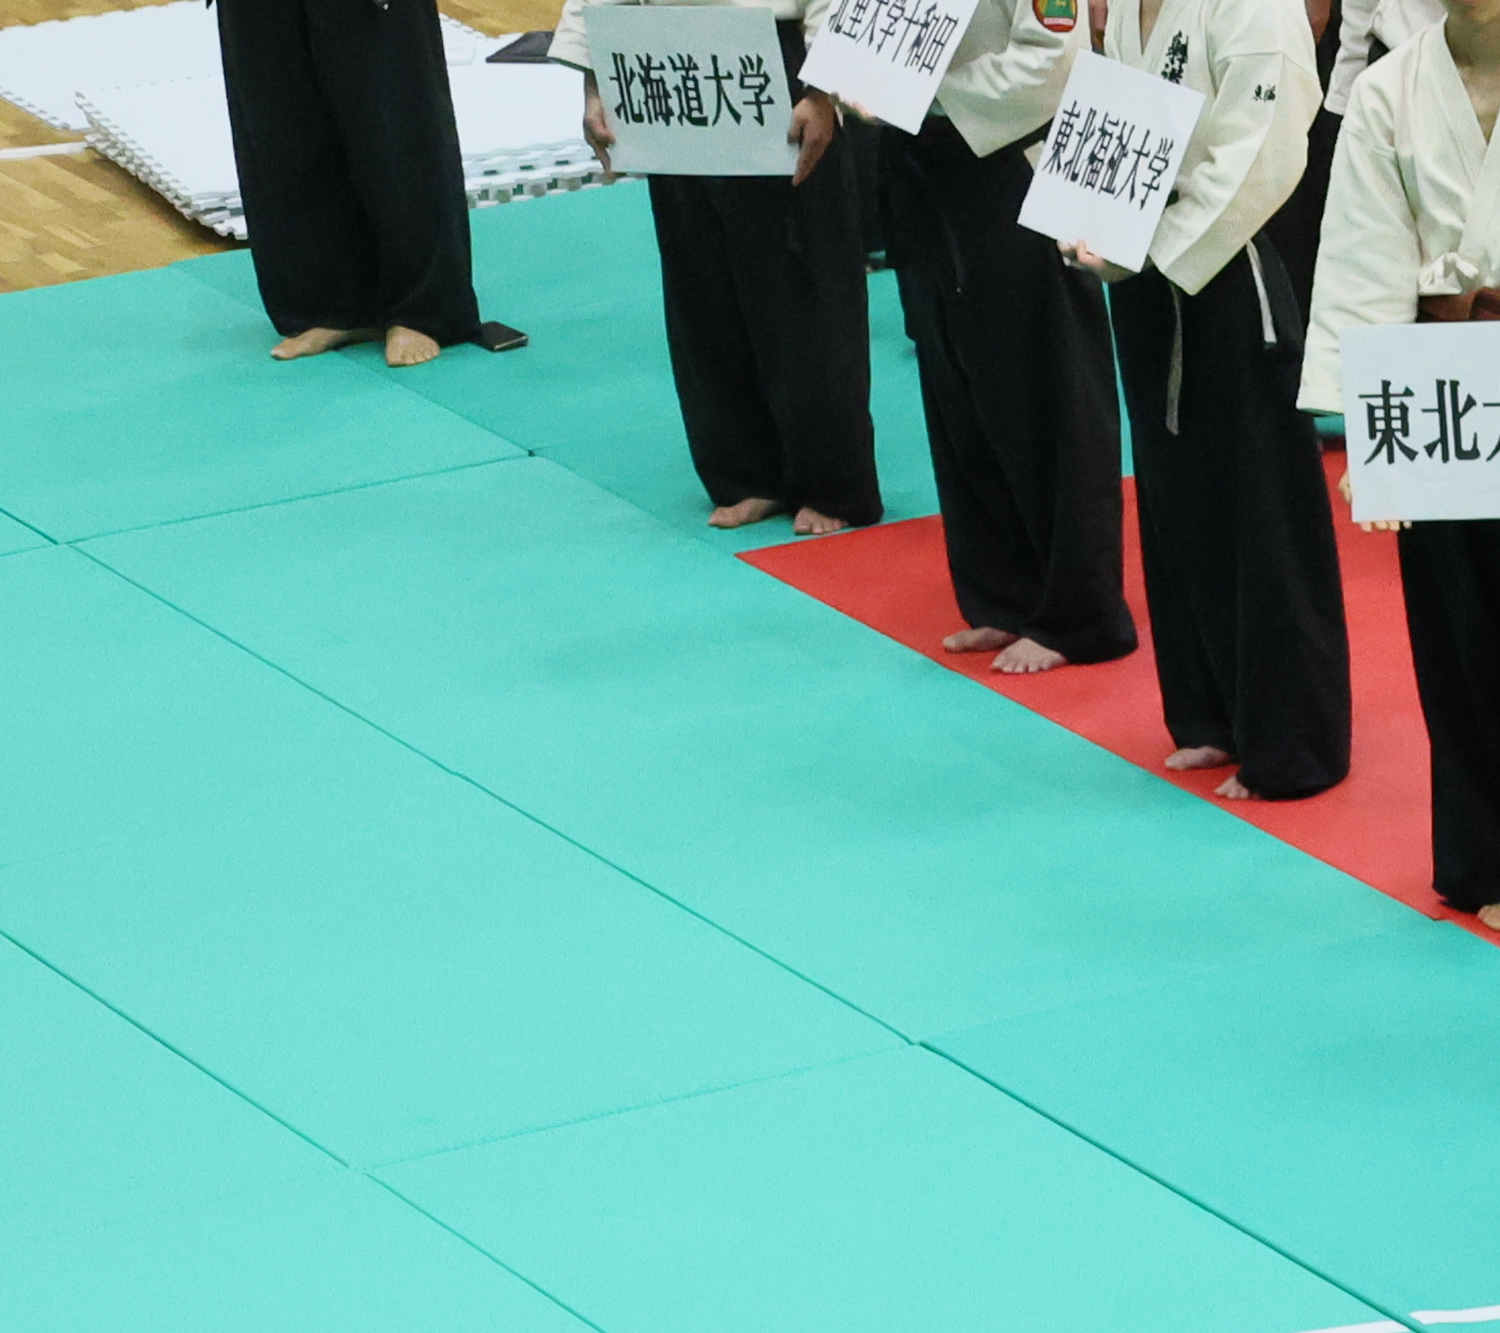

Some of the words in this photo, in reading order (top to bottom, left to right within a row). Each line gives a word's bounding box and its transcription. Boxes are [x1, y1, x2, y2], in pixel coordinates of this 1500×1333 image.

[609, 52, 775, 127] 北海道大学
[1042, 100, 1174, 211] 東北福祉大学
